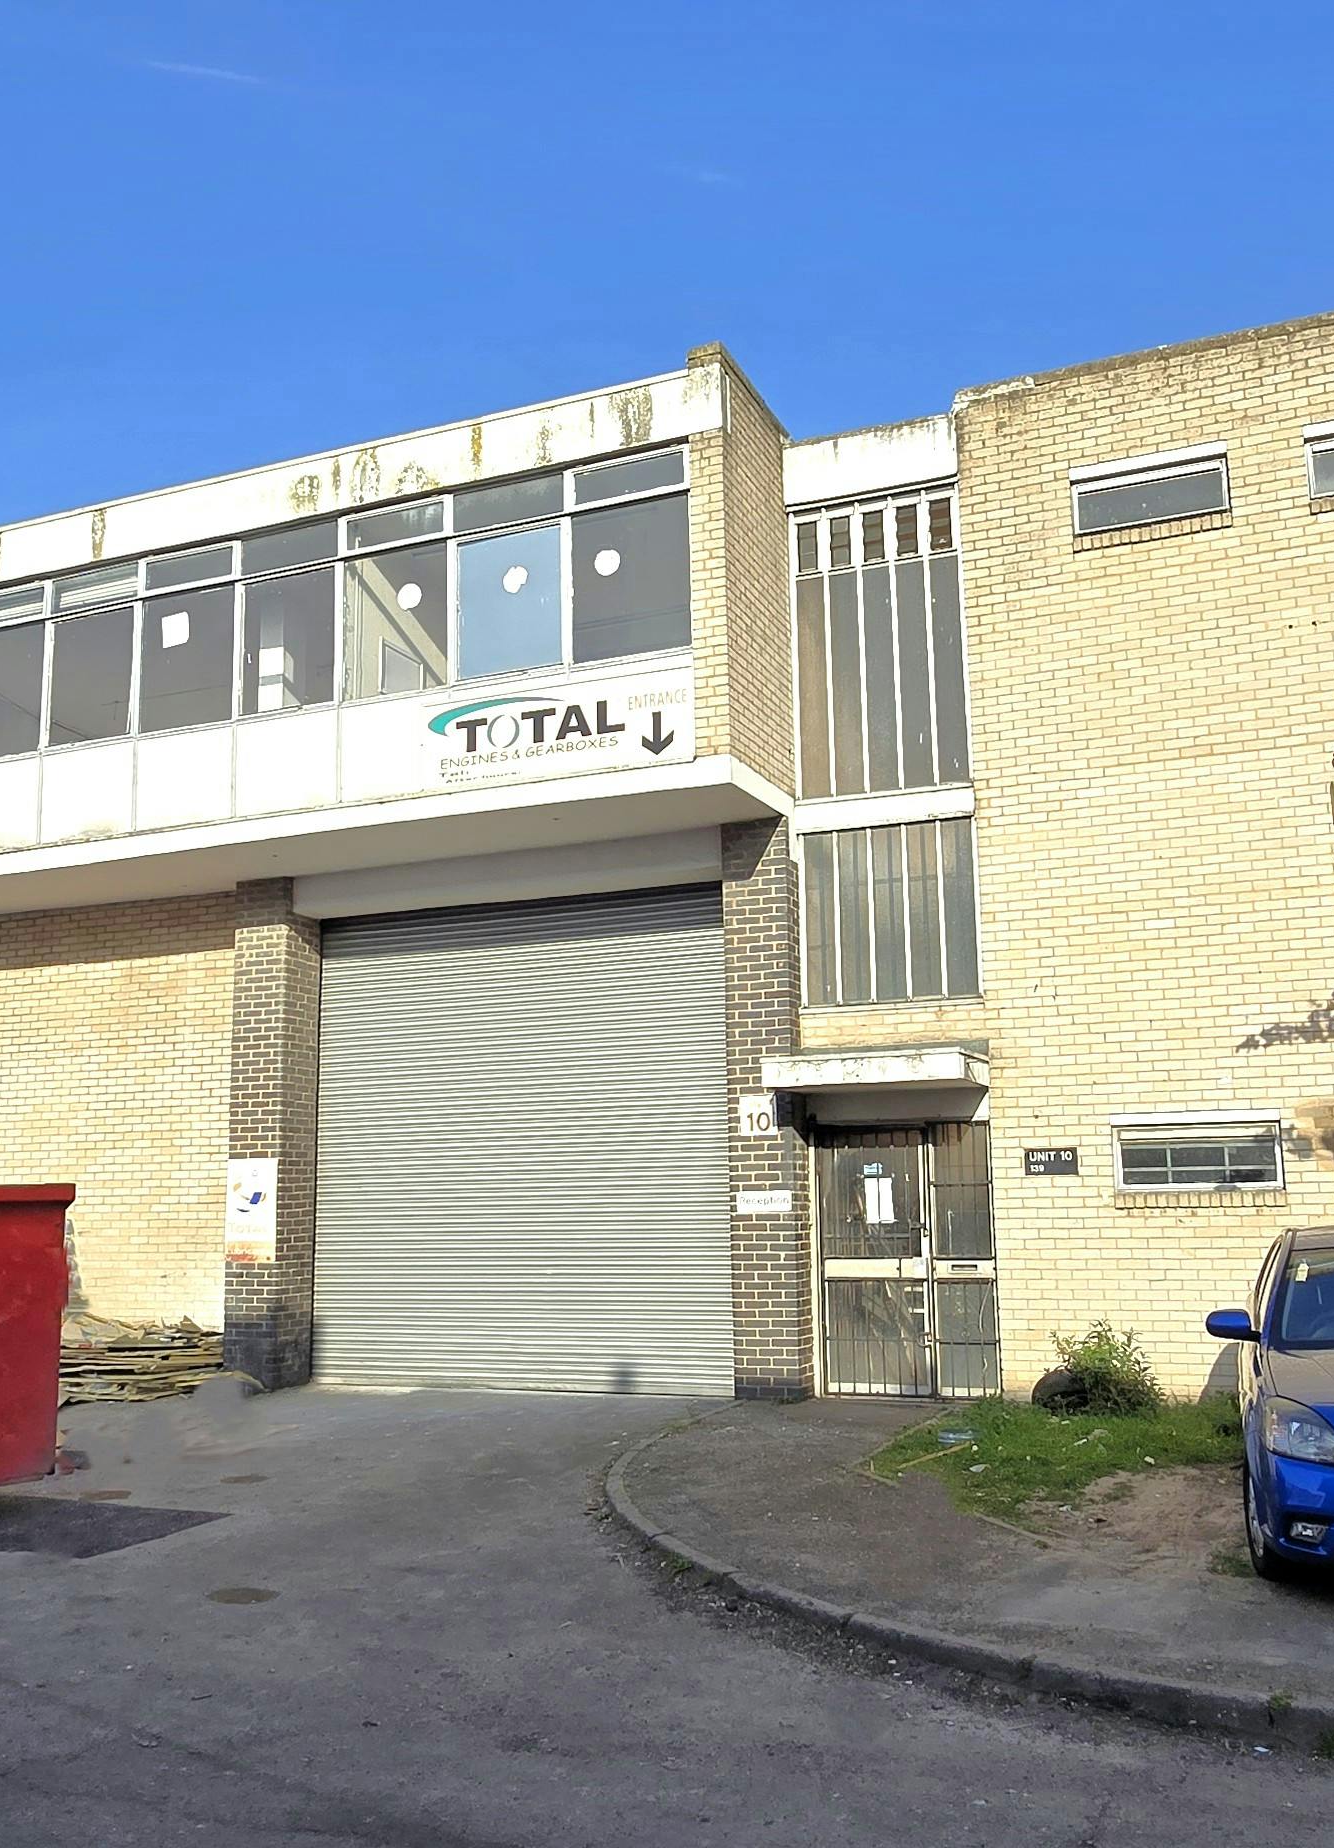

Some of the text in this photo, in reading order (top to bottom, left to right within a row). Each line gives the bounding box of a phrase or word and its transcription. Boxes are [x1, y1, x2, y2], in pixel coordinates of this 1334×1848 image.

[628, 688, 687, 711] ENTRANCE
[456, 700, 626, 753] TOTAL
[440, 736, 619, 770] ENGINES & GEARBOXES
[747, 1111, 771, 1132] 10
[1028, 1150, 1073, 1162] UNIT 10
[739, 1196, 790, 1206] Reception
